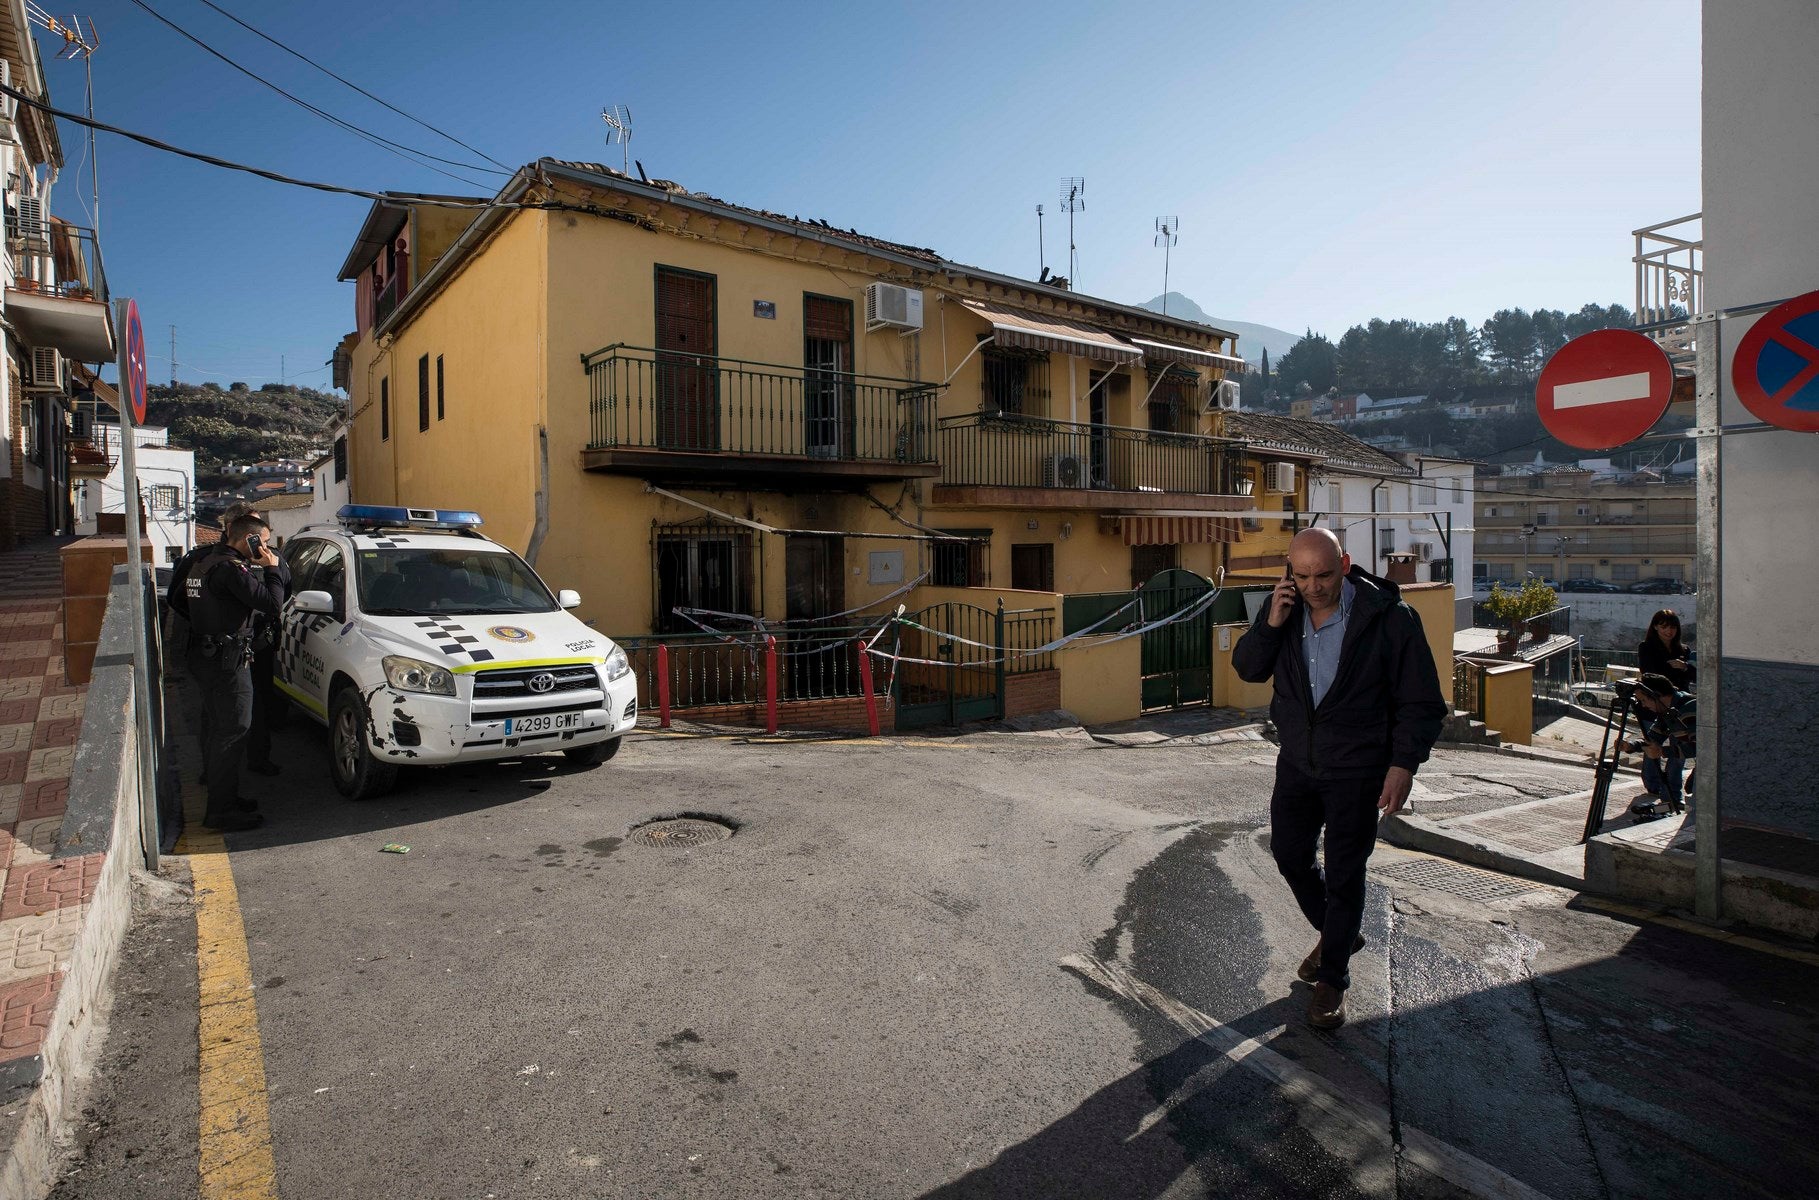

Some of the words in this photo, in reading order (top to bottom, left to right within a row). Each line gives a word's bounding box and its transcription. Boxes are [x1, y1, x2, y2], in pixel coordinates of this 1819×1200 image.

[186, 588, 201, 598] LOCAL
[570, 643, 596, 652] LOCAL
[303, 667, 321, 689] LOCAL
[515, 716, 551, 732] 4299
[555, 713, 580, 728] GWF
